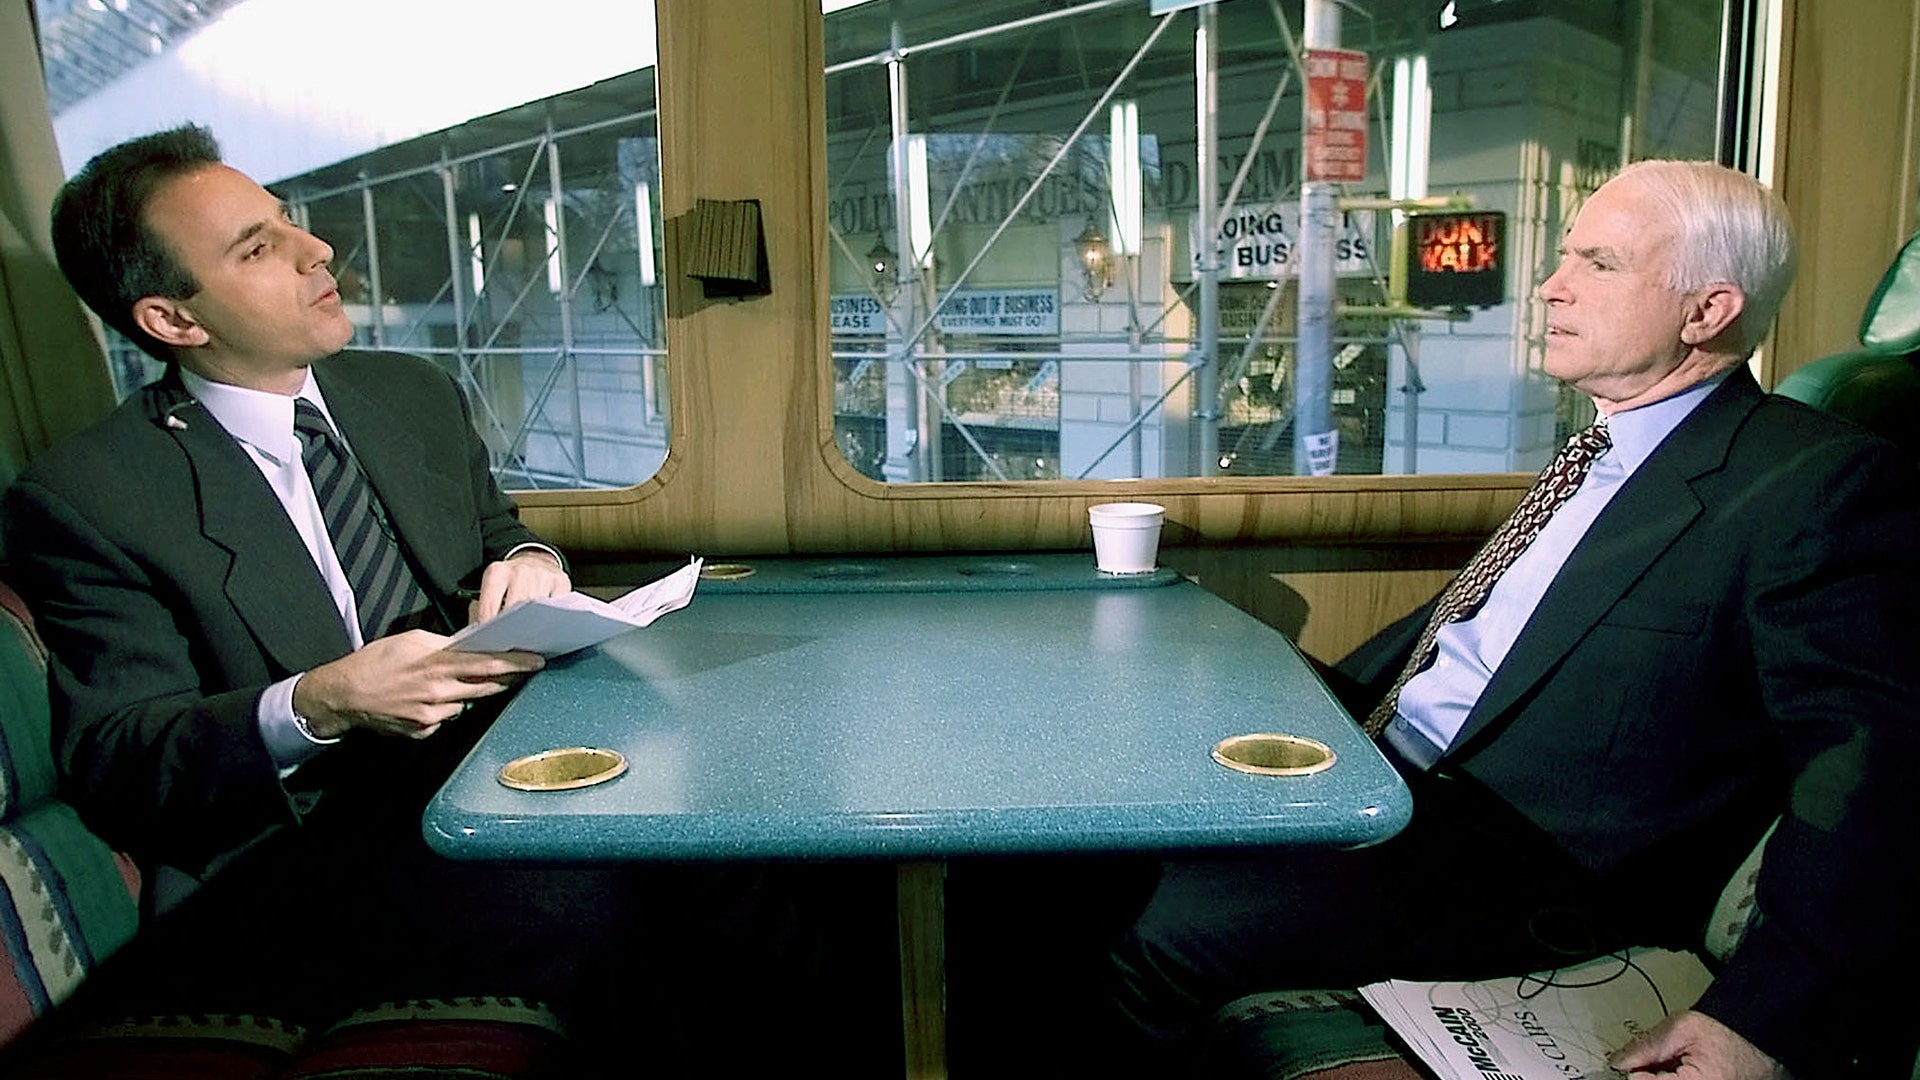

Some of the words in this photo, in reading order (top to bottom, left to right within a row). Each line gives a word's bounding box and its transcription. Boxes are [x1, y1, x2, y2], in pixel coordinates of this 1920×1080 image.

[1219, 213, 1283, 241] OING
[1237, 238, 1370, 267] BUSSS
[830, 296, 881, 314] USINESS
[1004, 294, 1054, 314] BUSINESS
[831, 315, 871, 328] EASE
[1454, 1007, 1490, 1041] 2000
[1513, 1009, 1566, 1061] CLIPS
